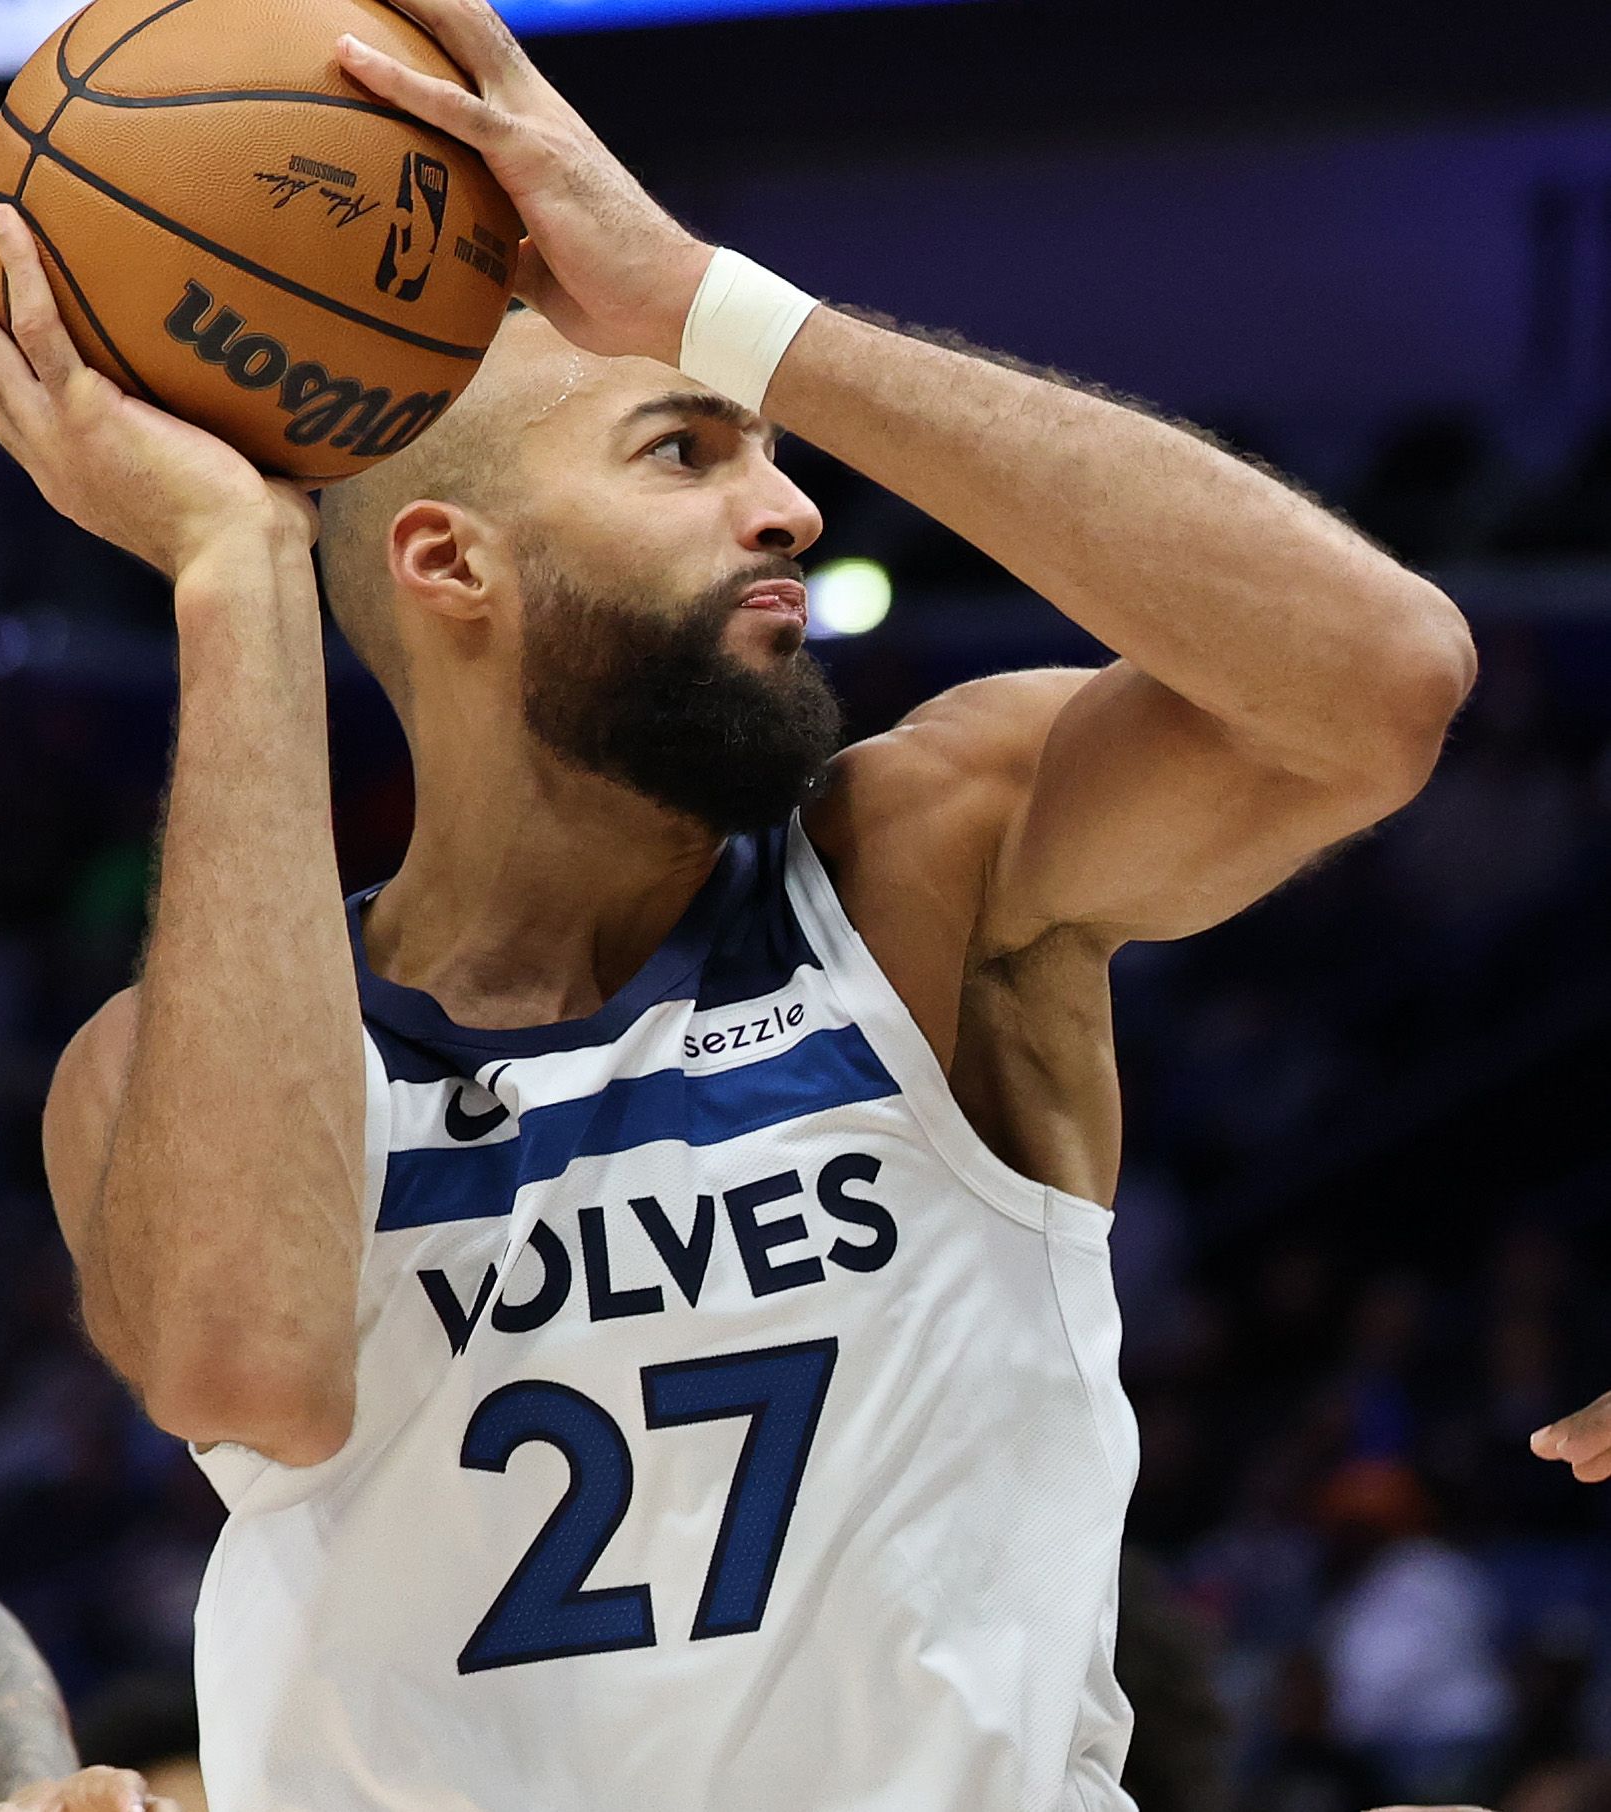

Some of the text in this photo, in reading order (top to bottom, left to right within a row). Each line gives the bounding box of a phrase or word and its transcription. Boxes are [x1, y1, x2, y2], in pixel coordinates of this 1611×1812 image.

[420, 162, 444, 192] NBA
[684, 1003, 804, 1058] sezzle
[457, 1337, 838, 1675] 27
